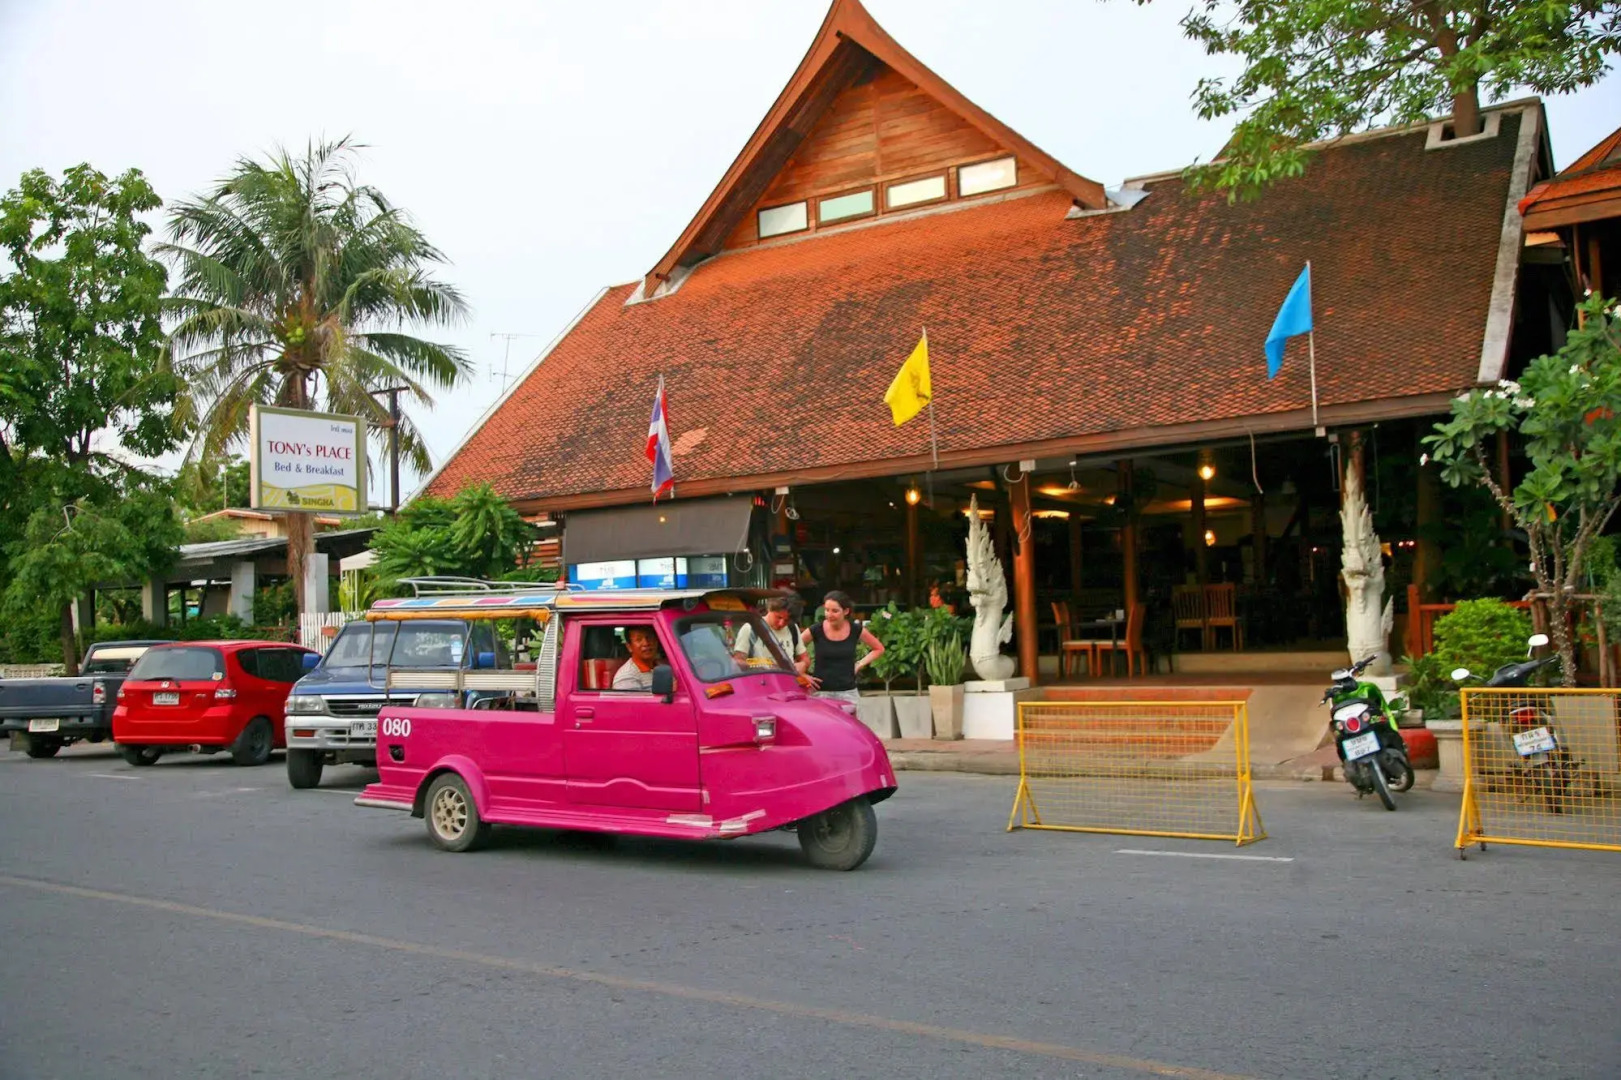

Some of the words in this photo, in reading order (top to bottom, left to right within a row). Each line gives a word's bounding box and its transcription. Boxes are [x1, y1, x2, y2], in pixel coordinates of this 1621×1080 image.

[267, 440, 312, 457] TONY's
[316, 445, 352, 460] PLACE
[274, 461, 292, 473] Bed
[295, 463, 302, 473] &
[305, 464, 345, 477] Breakfast
[301, 497, 335, 507] SINGHA
[382, 717, 412, 738] 080
